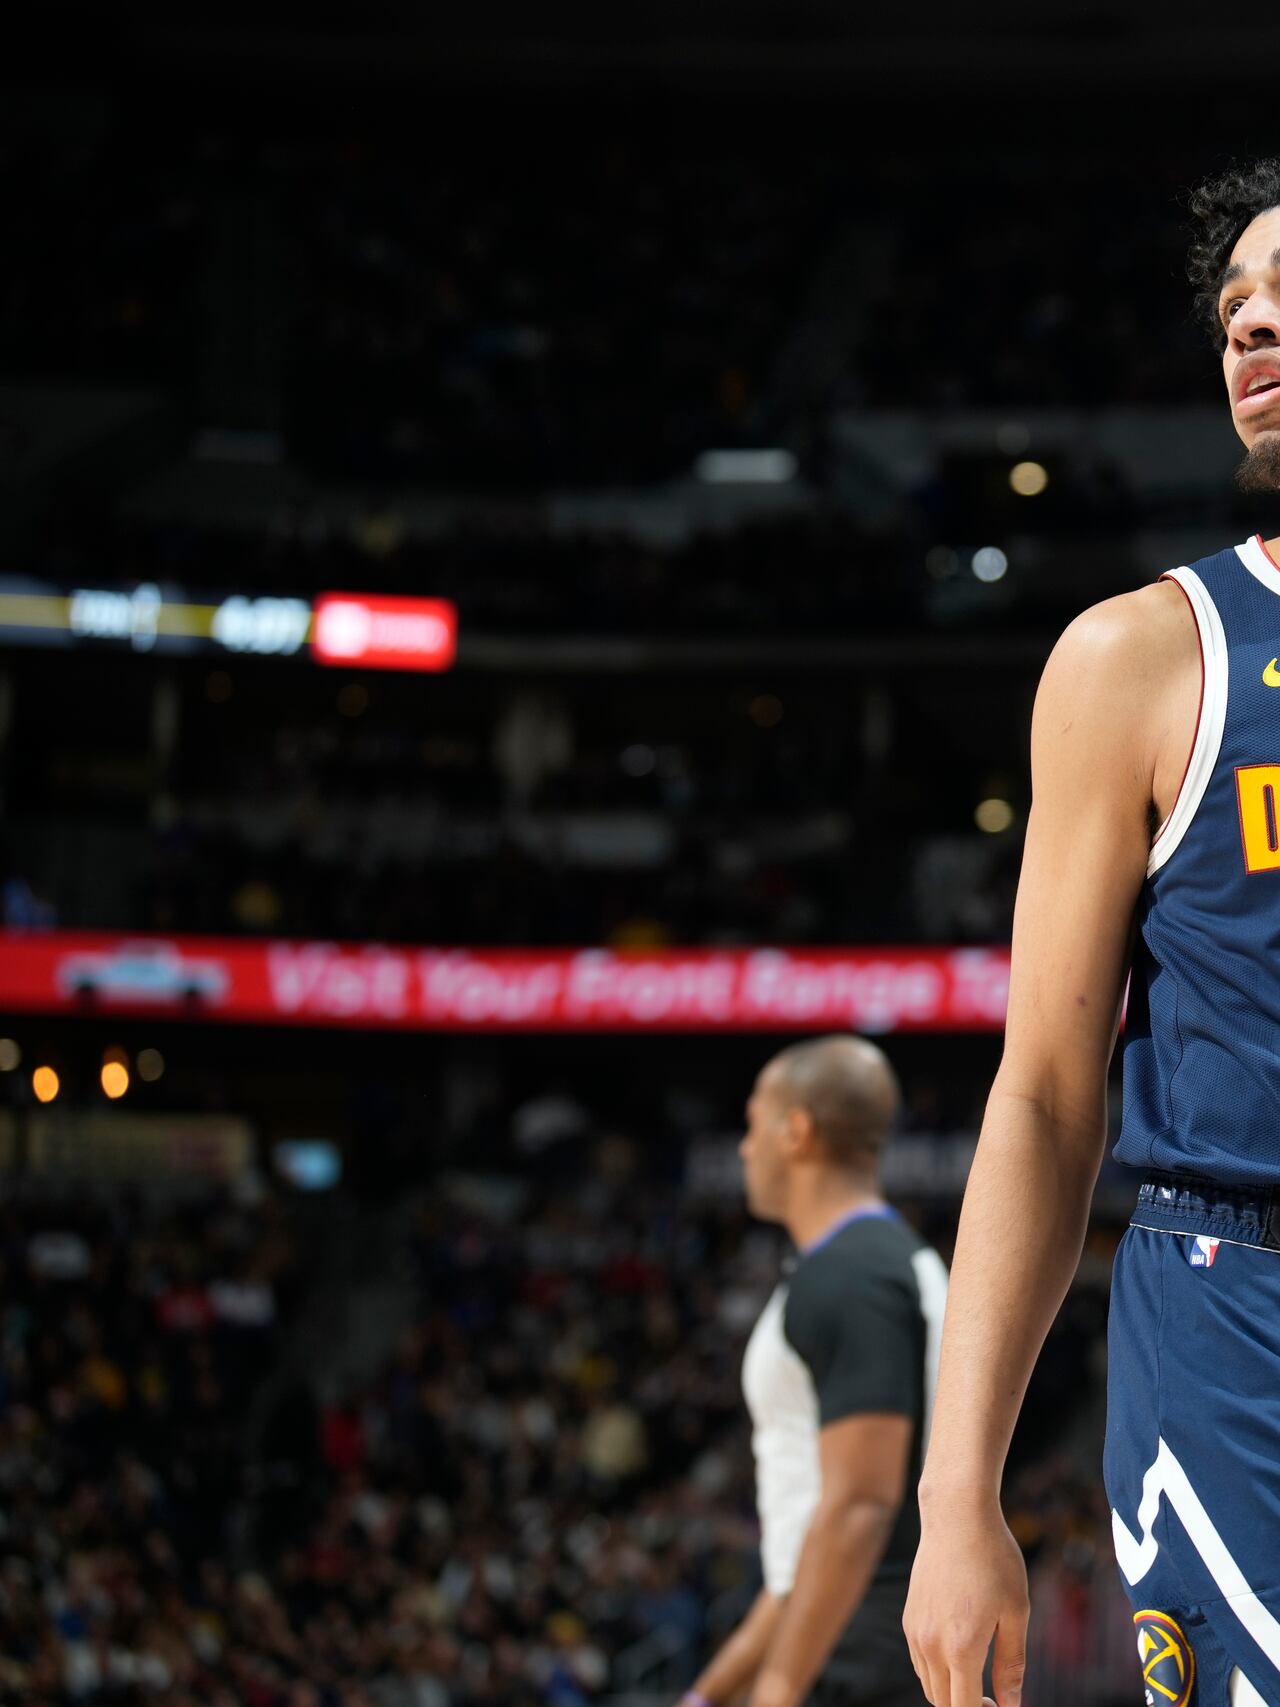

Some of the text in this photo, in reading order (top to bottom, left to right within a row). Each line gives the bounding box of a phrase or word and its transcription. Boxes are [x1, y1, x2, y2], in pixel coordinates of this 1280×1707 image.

[267, 941, 408, 1017] Visit
[418, 946, 560, 1022] Your
[568, 947, 738, 1023] Front
[742, 947, 942, 1033] Range
[1191, 1254, 1205, 1265] NBA
